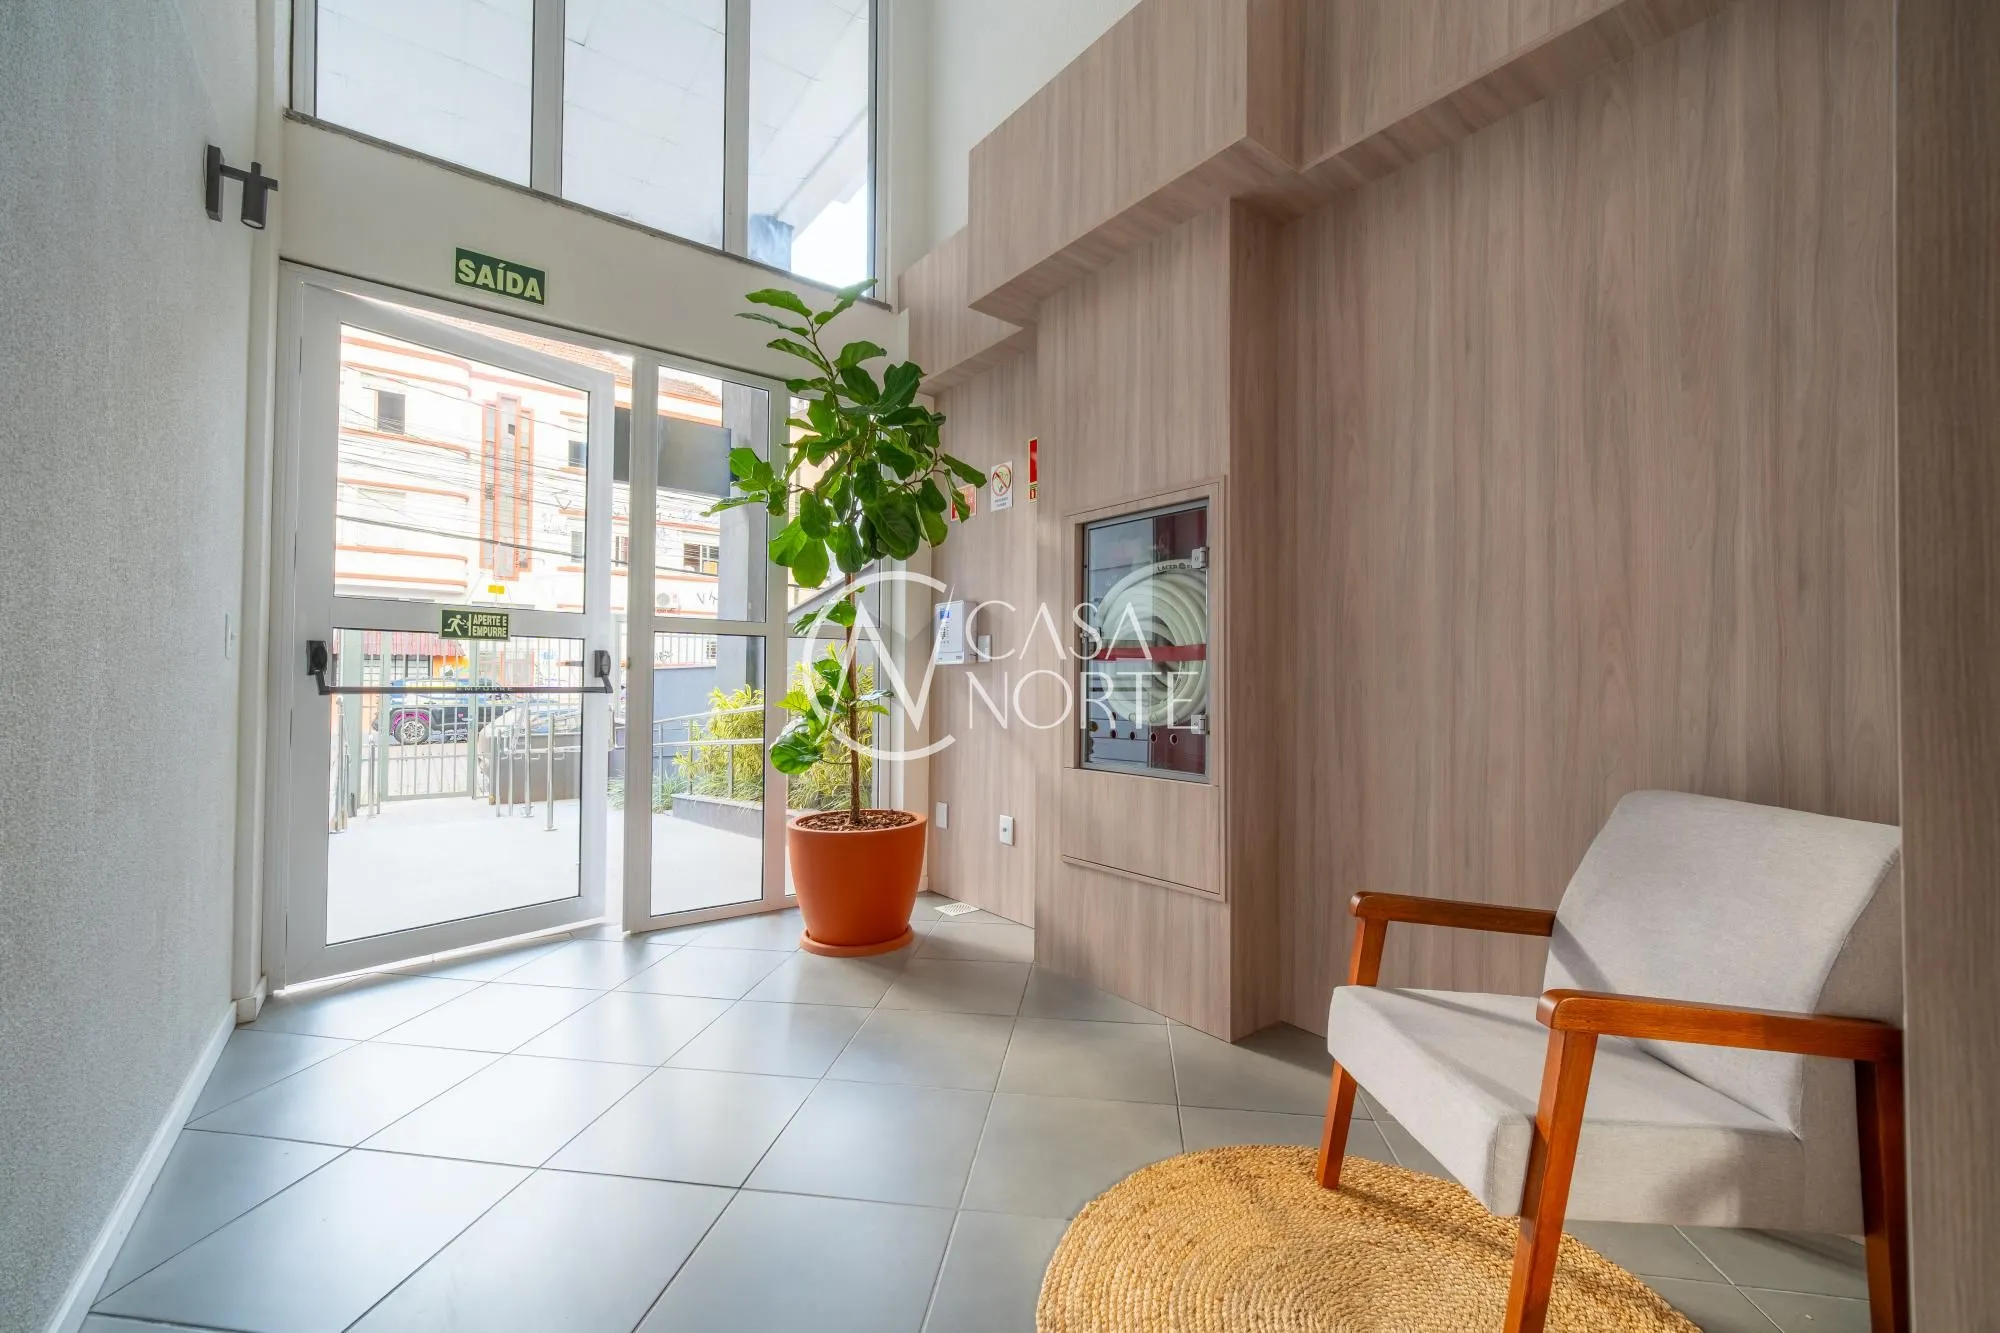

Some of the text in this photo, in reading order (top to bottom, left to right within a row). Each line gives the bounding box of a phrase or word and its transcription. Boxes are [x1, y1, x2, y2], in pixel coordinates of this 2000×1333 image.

[458, 259, 542, 301] SAÍDA
[473, 615, 507, 626] APERTE E
[472, 626, 507, 637] EMPURRE
